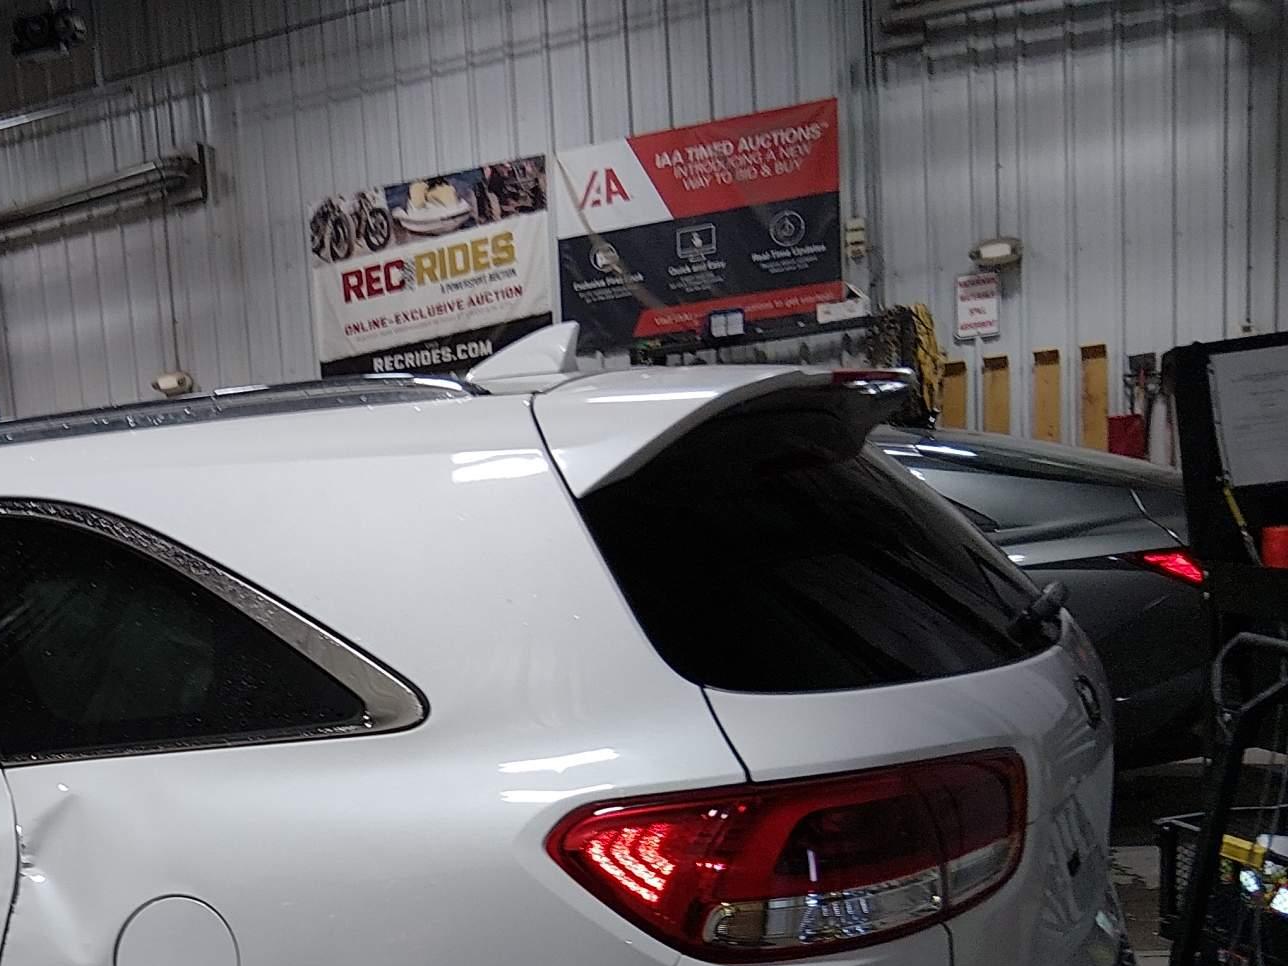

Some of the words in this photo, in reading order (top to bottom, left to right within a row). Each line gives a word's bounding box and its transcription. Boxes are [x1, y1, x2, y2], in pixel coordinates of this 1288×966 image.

[655, 151, 684, 169] IAA
[344, 299, 465, 337] ONLINE-EXCLUSIVE
[467, 284, 524, 307] AUCTION
[373, 338, 494, 373] RECRIDES.COM
